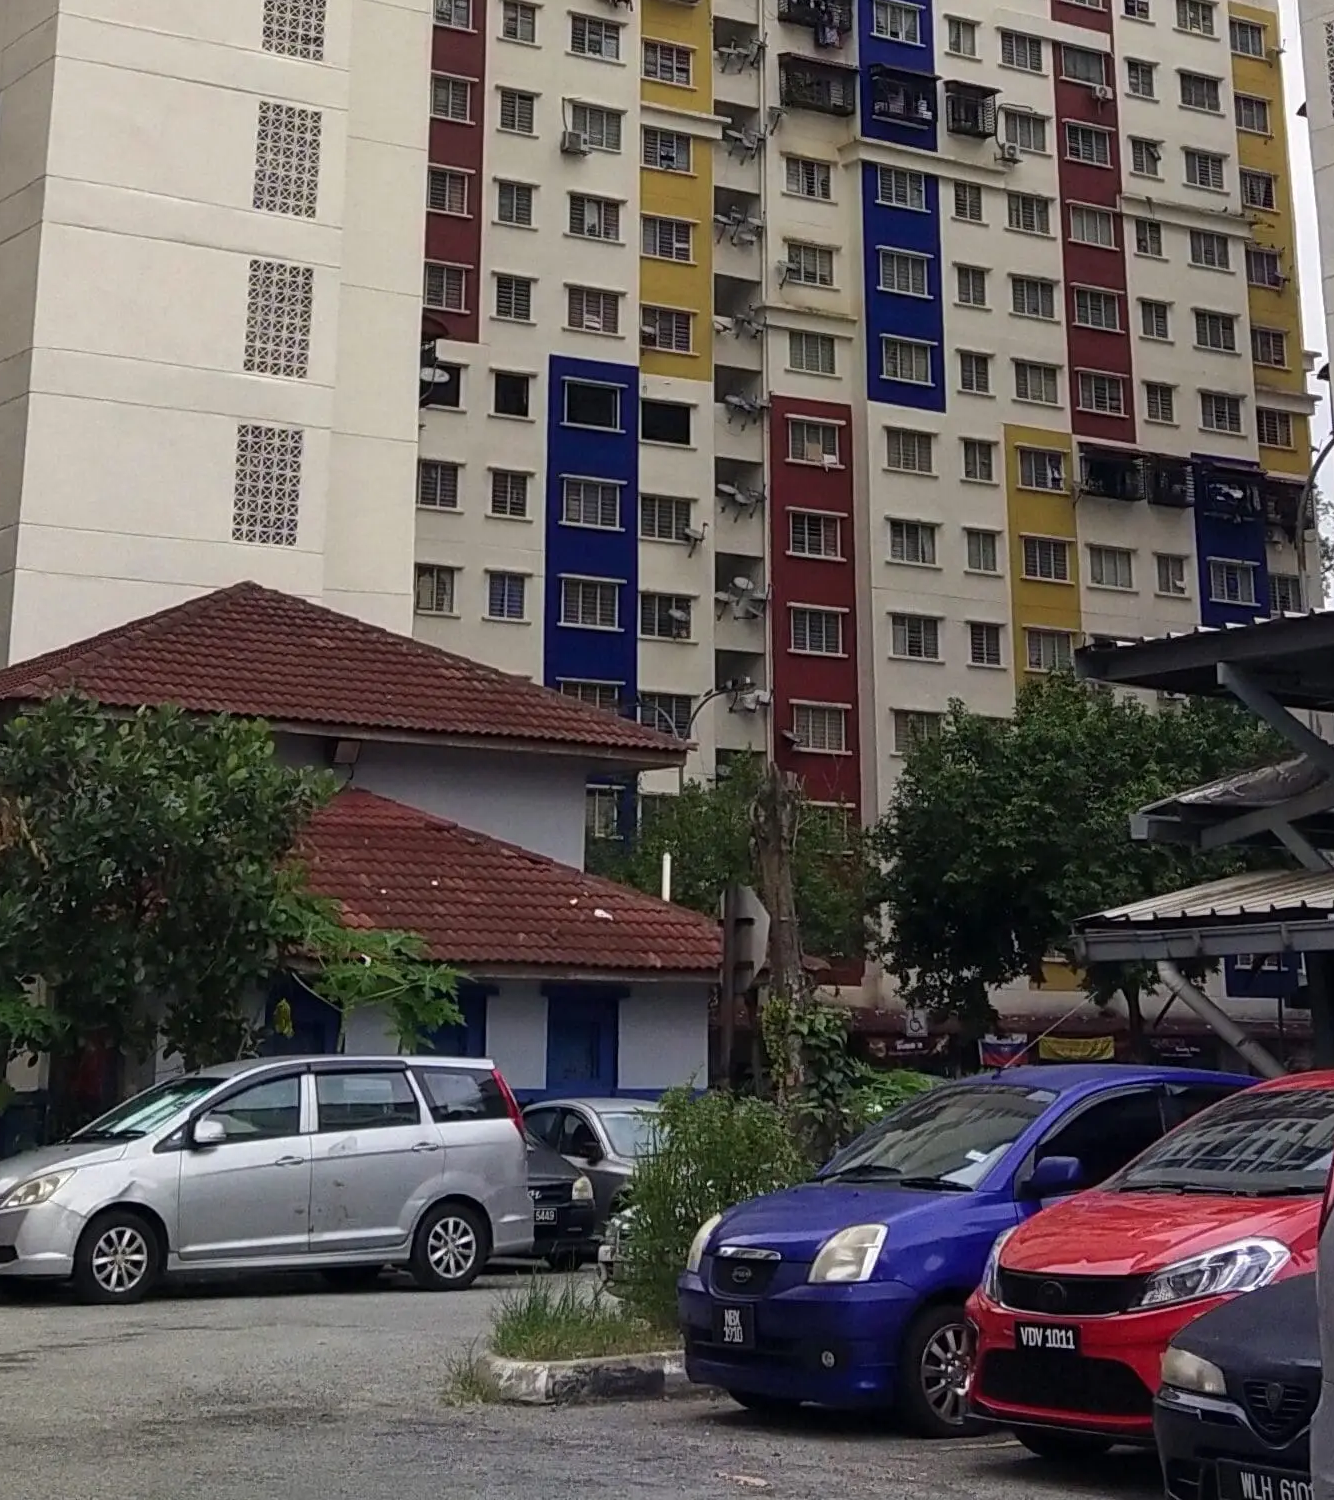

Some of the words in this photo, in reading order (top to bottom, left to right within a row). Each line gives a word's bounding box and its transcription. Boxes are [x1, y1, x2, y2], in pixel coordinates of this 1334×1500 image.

[1020, 1326, 1043, 1347] VDV
[1045, 1328, 1076, 1349] 1011
[1240, 1471, 1274, 1500] WLH
